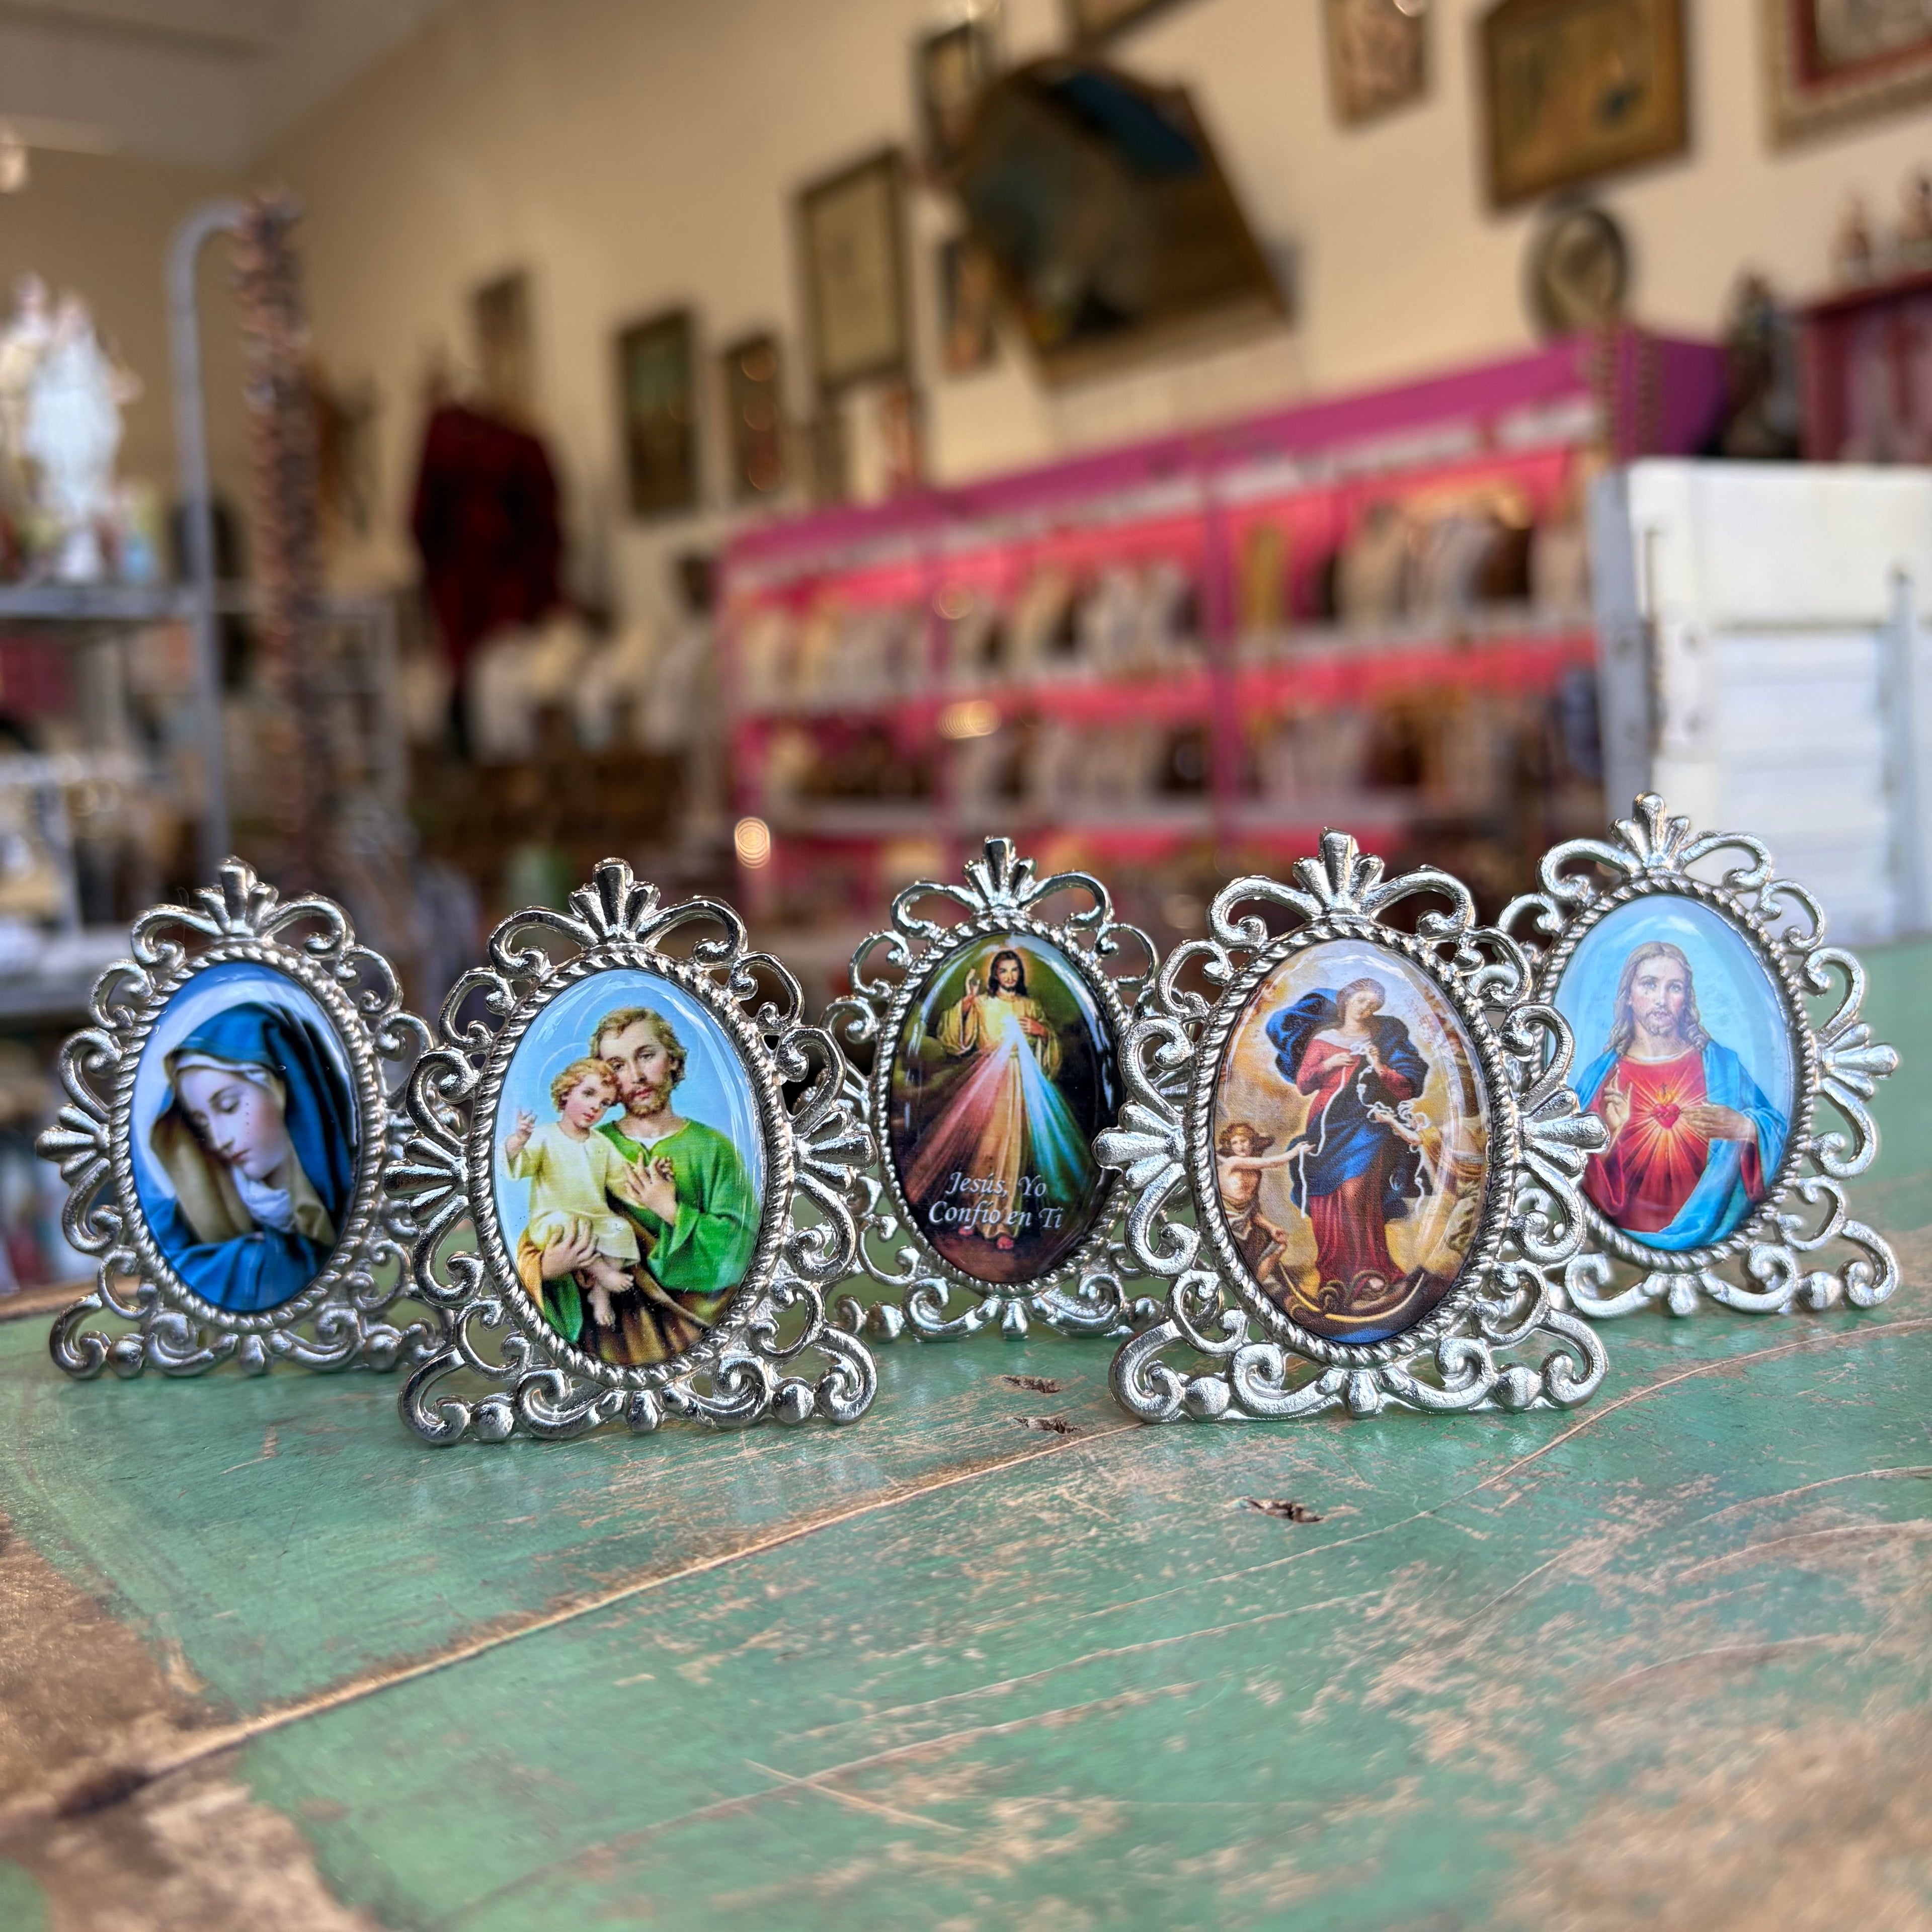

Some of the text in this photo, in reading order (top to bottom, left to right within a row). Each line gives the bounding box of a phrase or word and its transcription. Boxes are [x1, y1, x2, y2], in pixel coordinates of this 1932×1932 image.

[944, 1171, 1046, 1198] Jesús, Yo
[928, 1200, 1064, 1230] Confío en Ti
